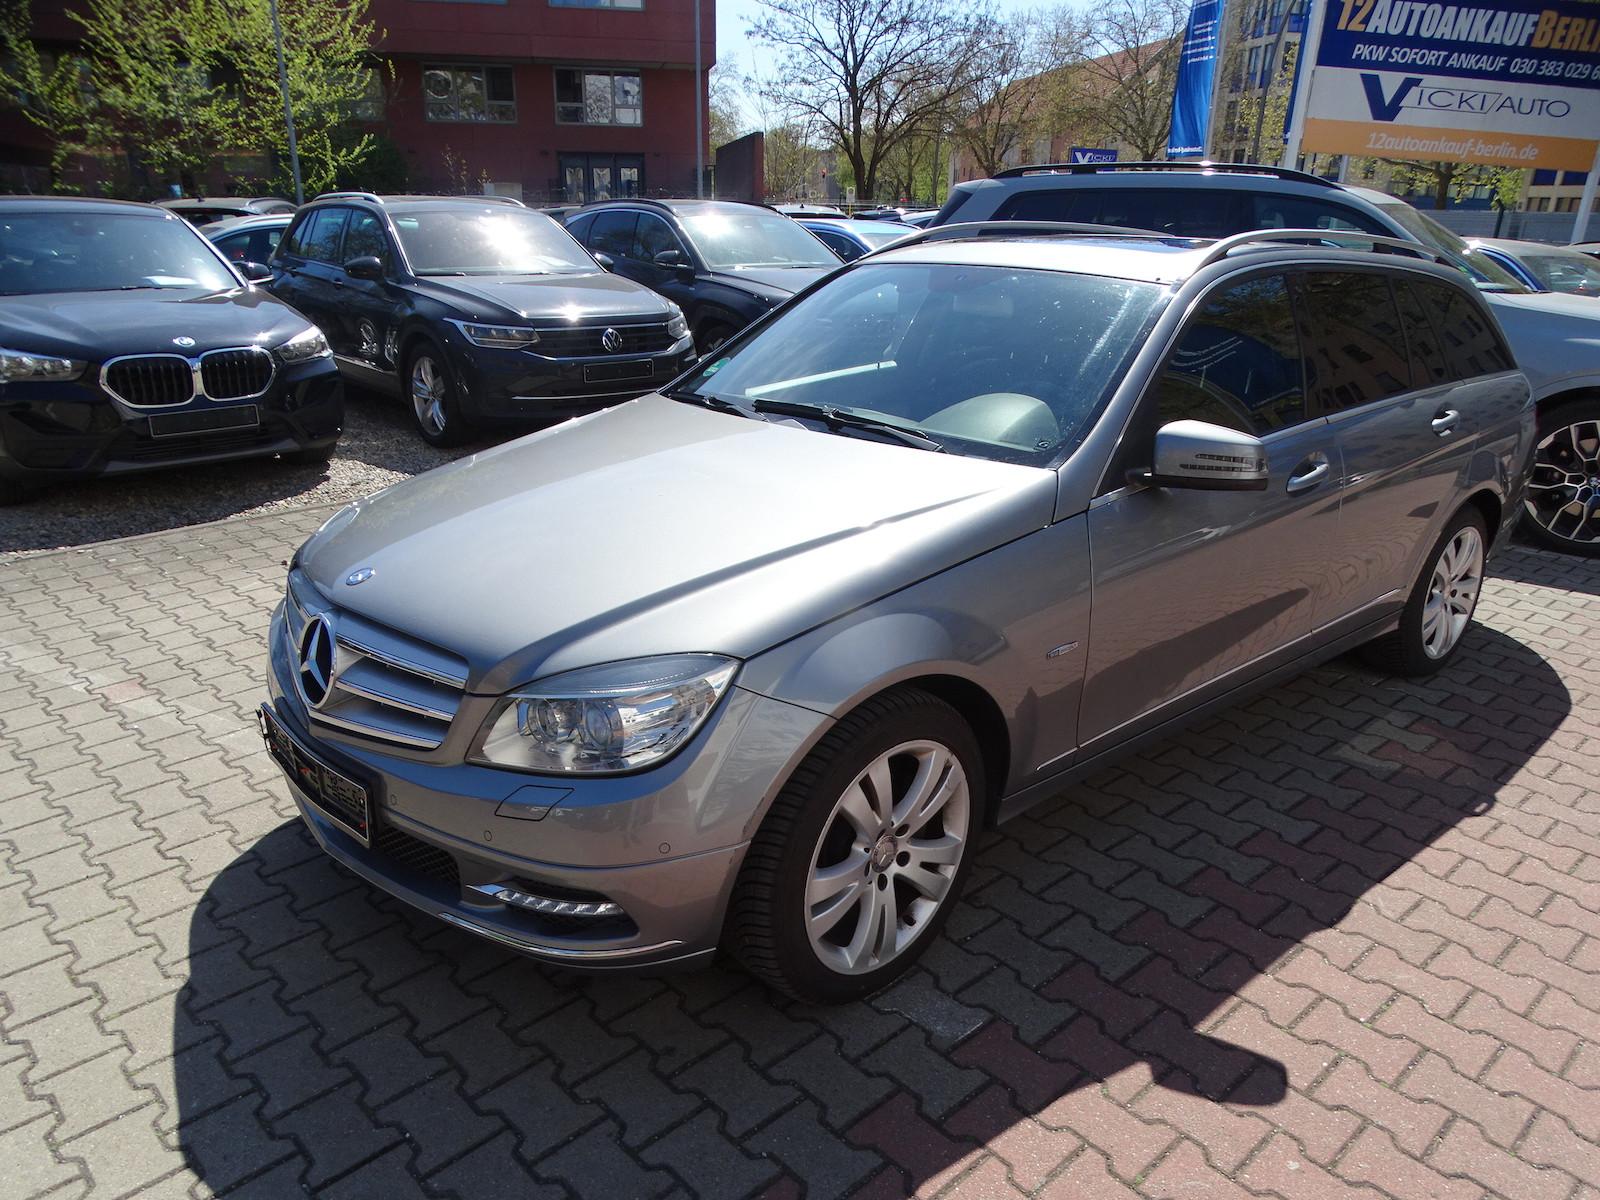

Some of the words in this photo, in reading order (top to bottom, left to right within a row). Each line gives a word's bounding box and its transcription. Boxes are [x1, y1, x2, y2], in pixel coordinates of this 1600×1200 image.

[1336, 0, 1600, 53] 12AUTOANKAUFBERLI
[1352, 44, 1389, 61] PKW
[1388, 47, 1450, 67] SOFORT
[1447, 52, 1508, 72] ANKAUF
[1509, 57, 1538, 74] 030
[1536, 60, 1566, 77] 383
[1564, 62, 1592, 79] 029
[1590, 64, 1600, 80] 6
[1360, 73, 1487, 121] VICKI
[1496, 95, 1571, 117] AUTO
[1365, 132, 1538, 160] 12autoankauf-berlin.de
